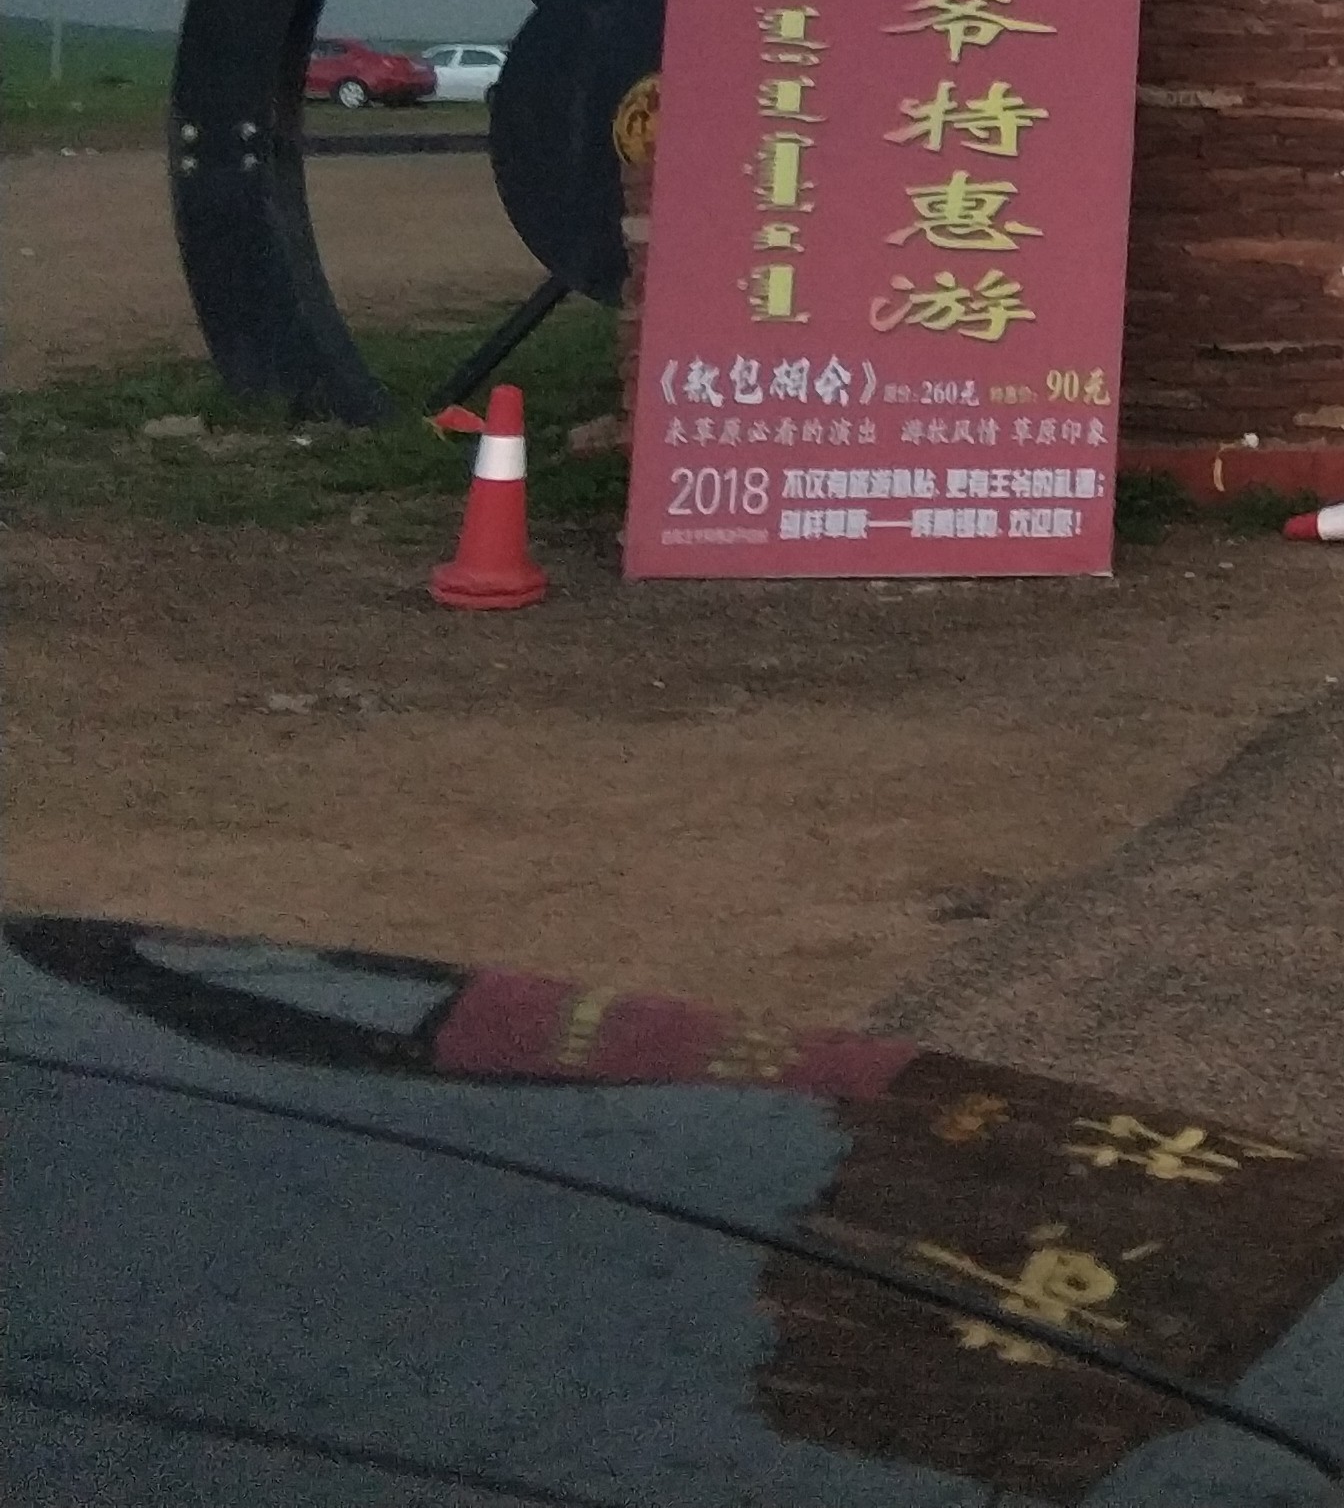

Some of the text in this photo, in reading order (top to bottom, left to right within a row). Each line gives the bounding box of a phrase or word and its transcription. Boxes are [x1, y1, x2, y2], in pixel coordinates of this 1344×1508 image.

[1011, 416, 1109, 449] 草原印象
[667, 466, 770, 516] 2018
